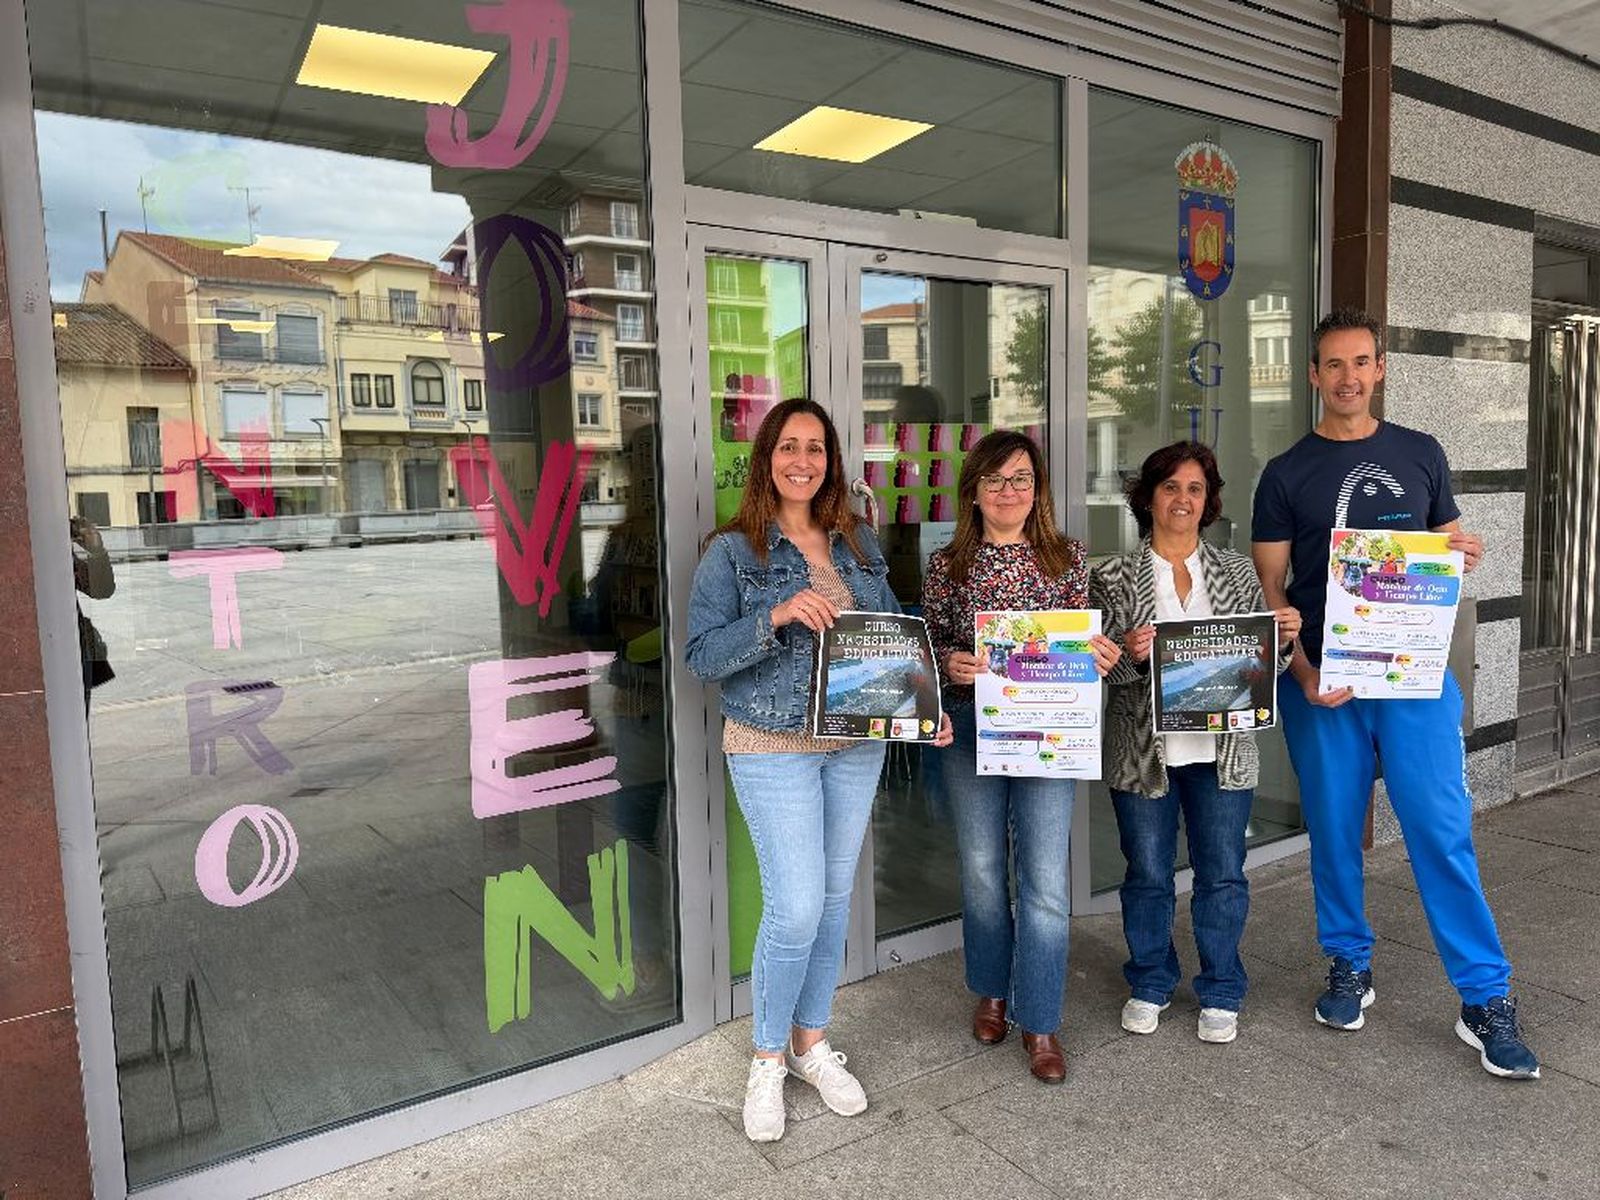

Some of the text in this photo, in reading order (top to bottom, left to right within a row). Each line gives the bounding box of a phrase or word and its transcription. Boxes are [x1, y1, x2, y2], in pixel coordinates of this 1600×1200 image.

[865, 621, 901, 633] CURSO
[1193, 624, 1236, 636] CURSO
[1166, 635, 1259, 651] NECESIDADES
